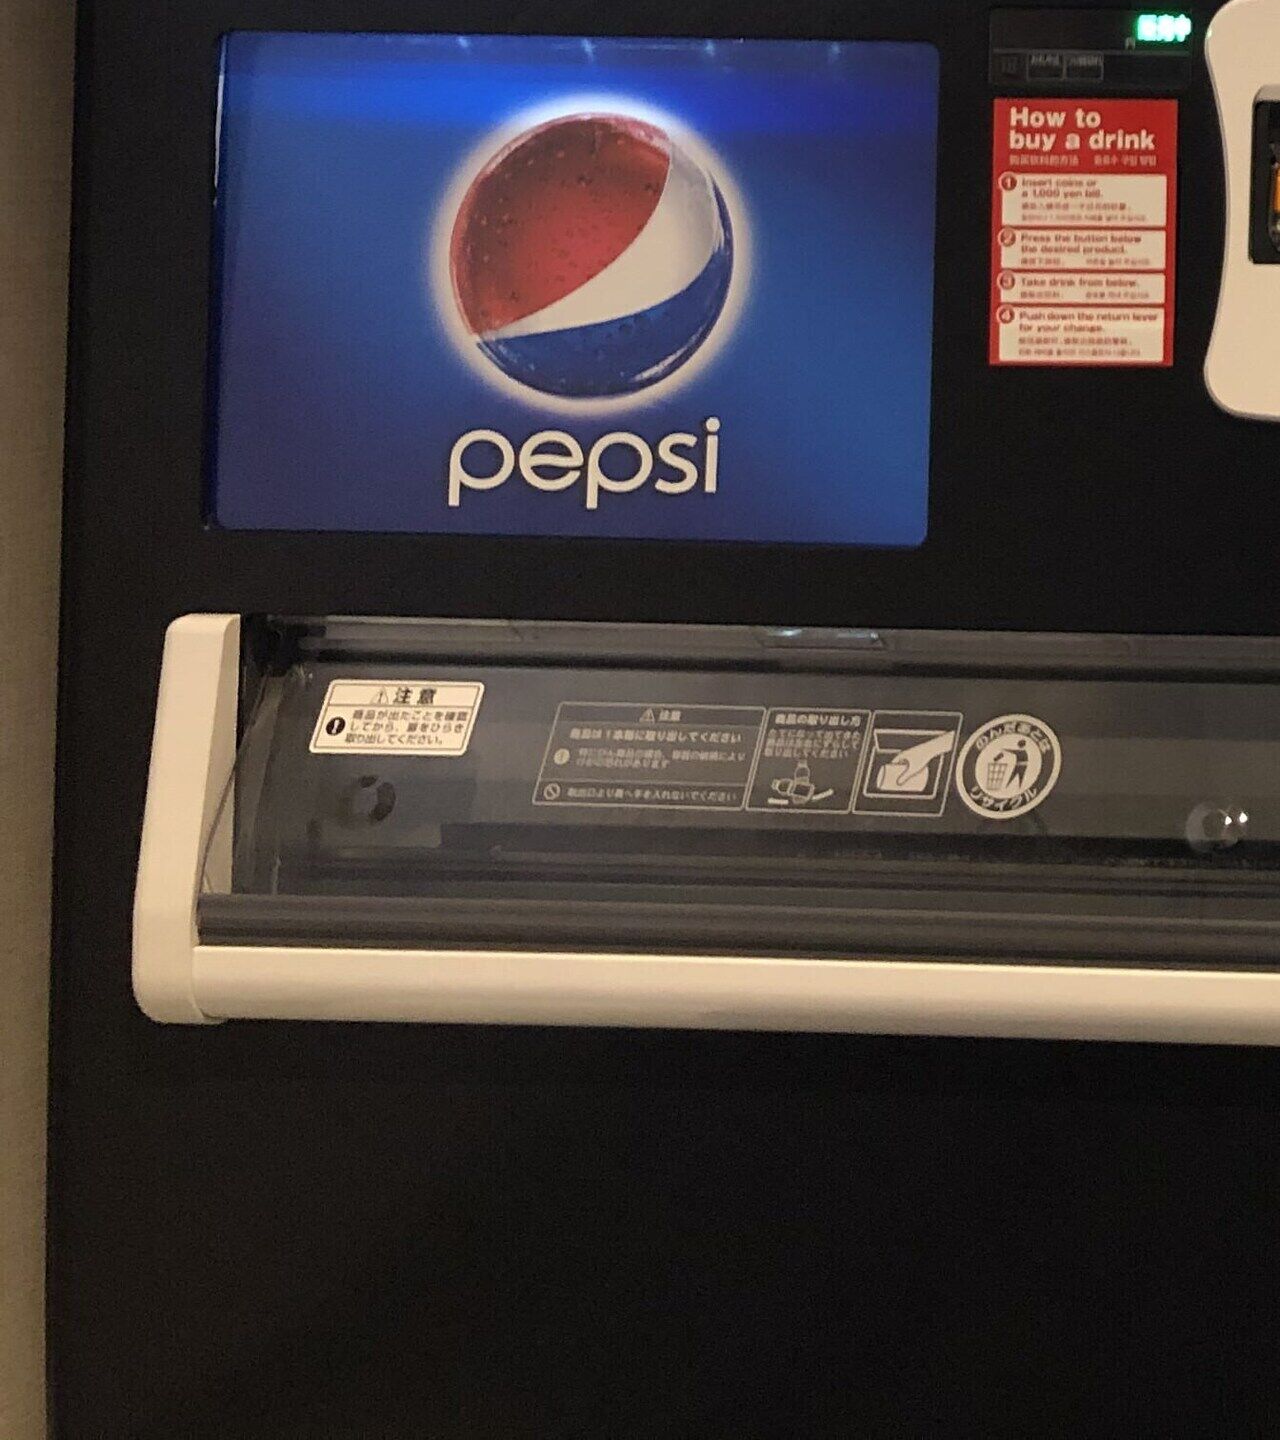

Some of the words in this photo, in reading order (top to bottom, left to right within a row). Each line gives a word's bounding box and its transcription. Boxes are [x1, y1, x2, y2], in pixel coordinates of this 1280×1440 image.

[1009, 106, 1067, 128] How
[1075, 107, 1102, 128] to
[1009, 129, 1056, 152] buy
[1065, 132, 1080, 150] a
[1088, 129, 1155, 150] drink
[447, 416, 722, 510] pepsi
[393, 687, 437, 705] 注意
